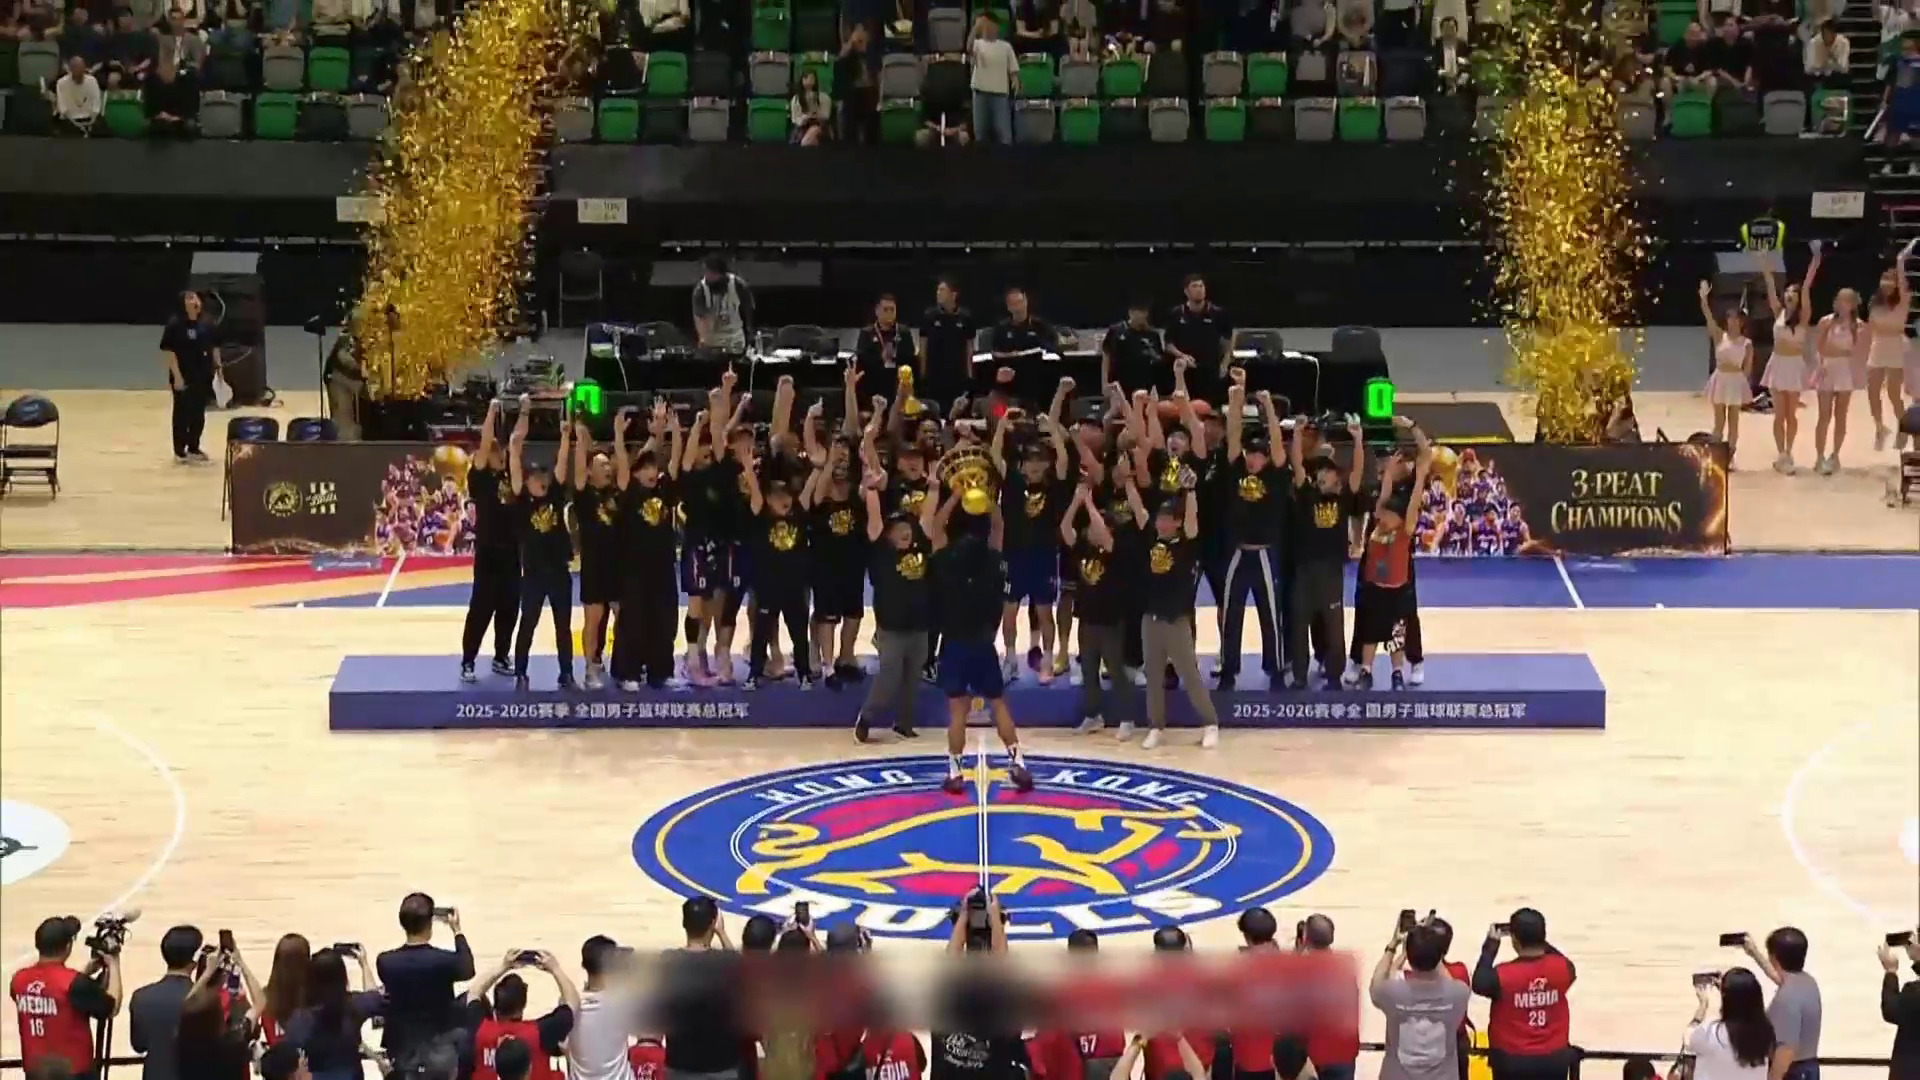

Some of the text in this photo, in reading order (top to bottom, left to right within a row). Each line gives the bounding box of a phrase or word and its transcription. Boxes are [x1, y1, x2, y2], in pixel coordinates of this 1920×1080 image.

[1368, 383, 1393, 417] 0
[1571, 469, 1663, 498] 3-PEAT
[1551, 500, 1682, 534] CHAMPIONS
[755, 769, 1209, 805] HONG KONG
[16, 994, 58, 1015] MEDIA
[1514, 989, 1559, 1008] MEDIA
[1528, 1009, 1546, 1026] 28
